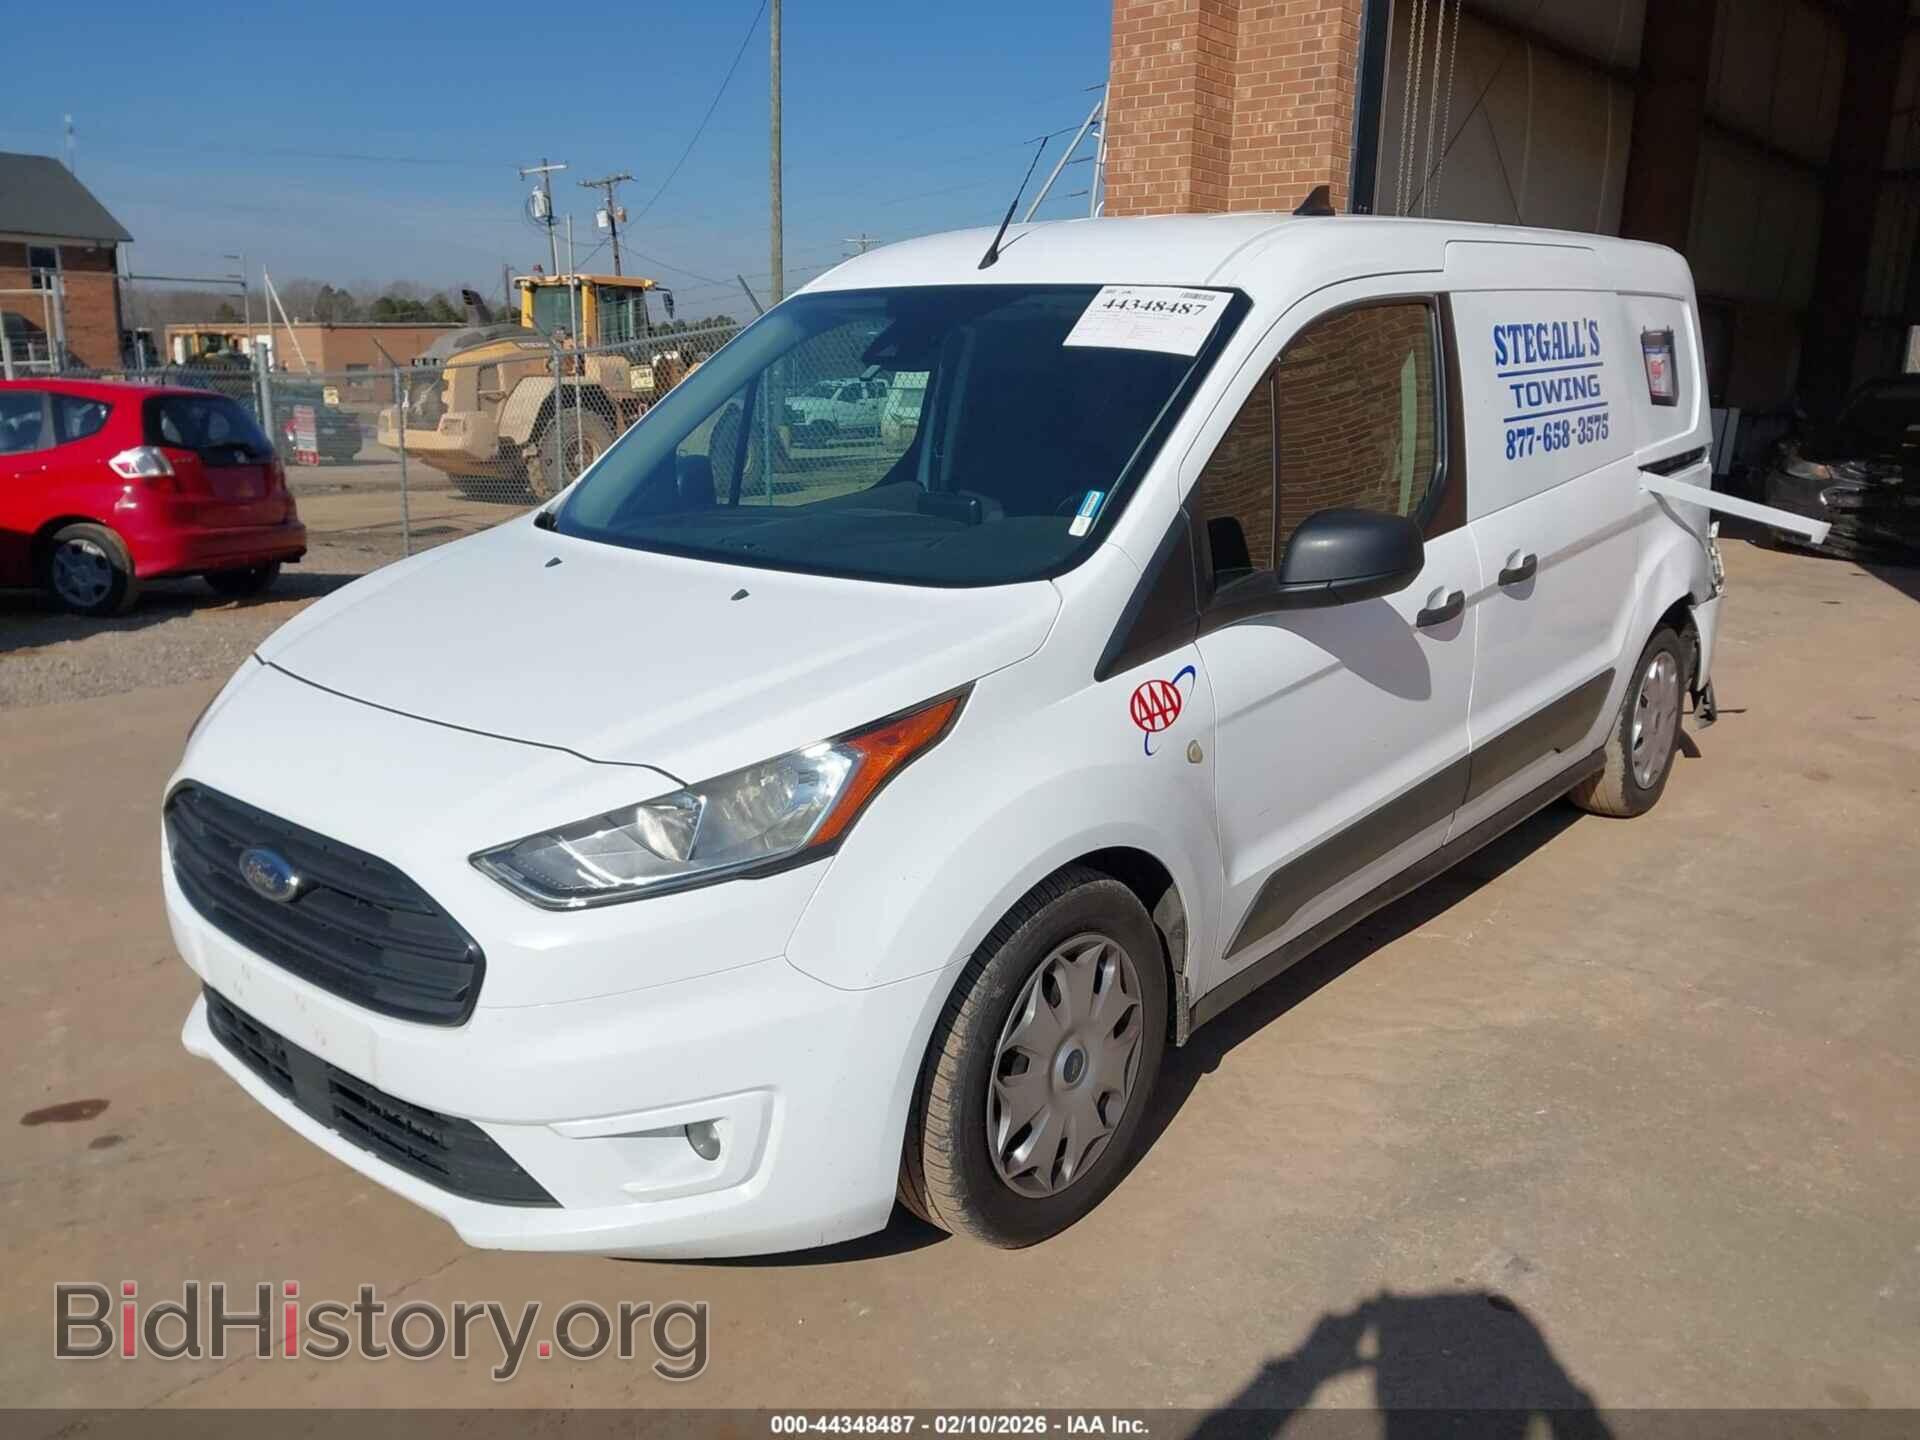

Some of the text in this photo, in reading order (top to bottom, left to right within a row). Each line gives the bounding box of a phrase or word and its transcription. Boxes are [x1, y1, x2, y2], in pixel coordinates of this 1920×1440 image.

[1102, 298, 1208, 316] 44348487
[1493, 318, 1600, 366] STEGALL'S
[1509, 374, 1601, 409] TOWING
[1505, 412, 1609, 461] 877-658-3575
[1132, 680, 1180, 731] AAA
